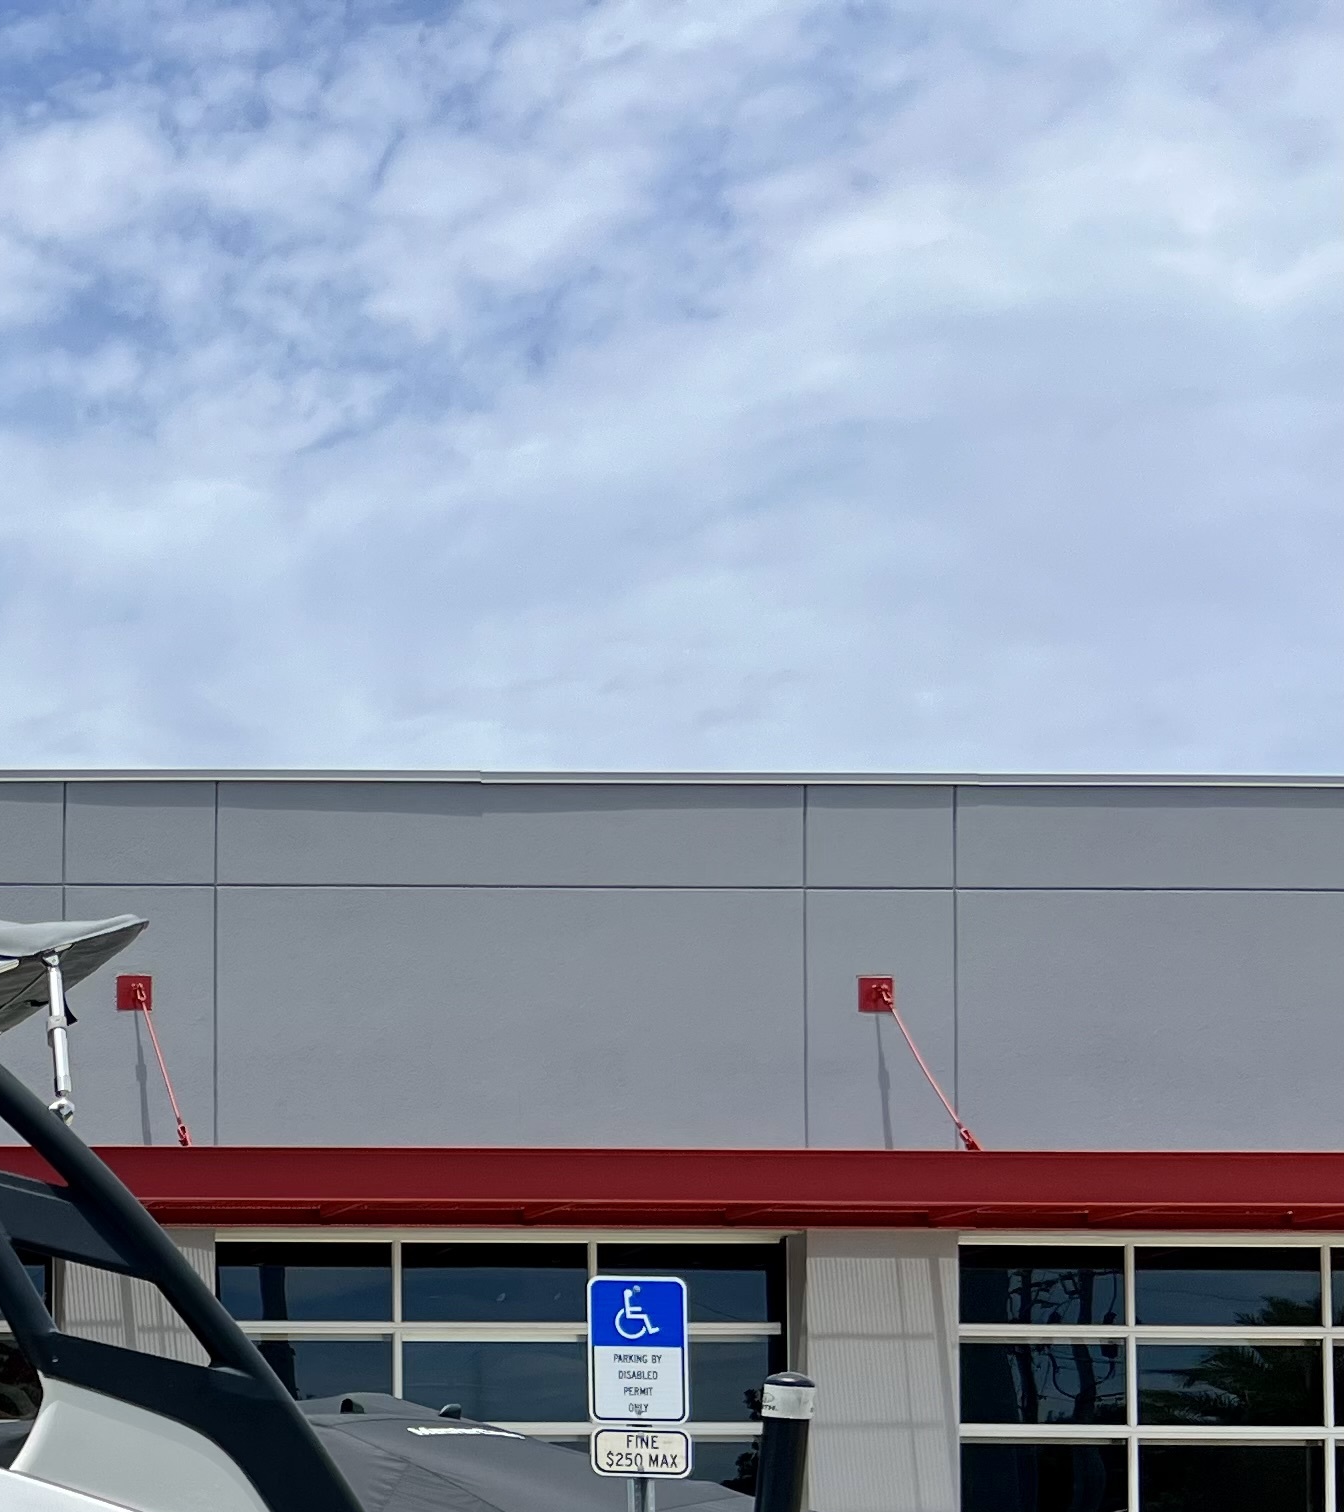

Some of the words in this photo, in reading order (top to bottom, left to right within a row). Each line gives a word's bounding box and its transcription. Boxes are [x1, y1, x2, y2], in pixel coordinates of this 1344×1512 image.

[613, 1353, 648, 1364] PARKING
[651, 1354, 662, 1364] BY
[618, 1370, 658, 1380] DISABLED
[623, 1386, 653, 1396] PERMIT
[626, 1434, 660, 1450] FINE
[605, 1450, 643, 1468] $250
[648, 1453, 678, 1469] MAX
